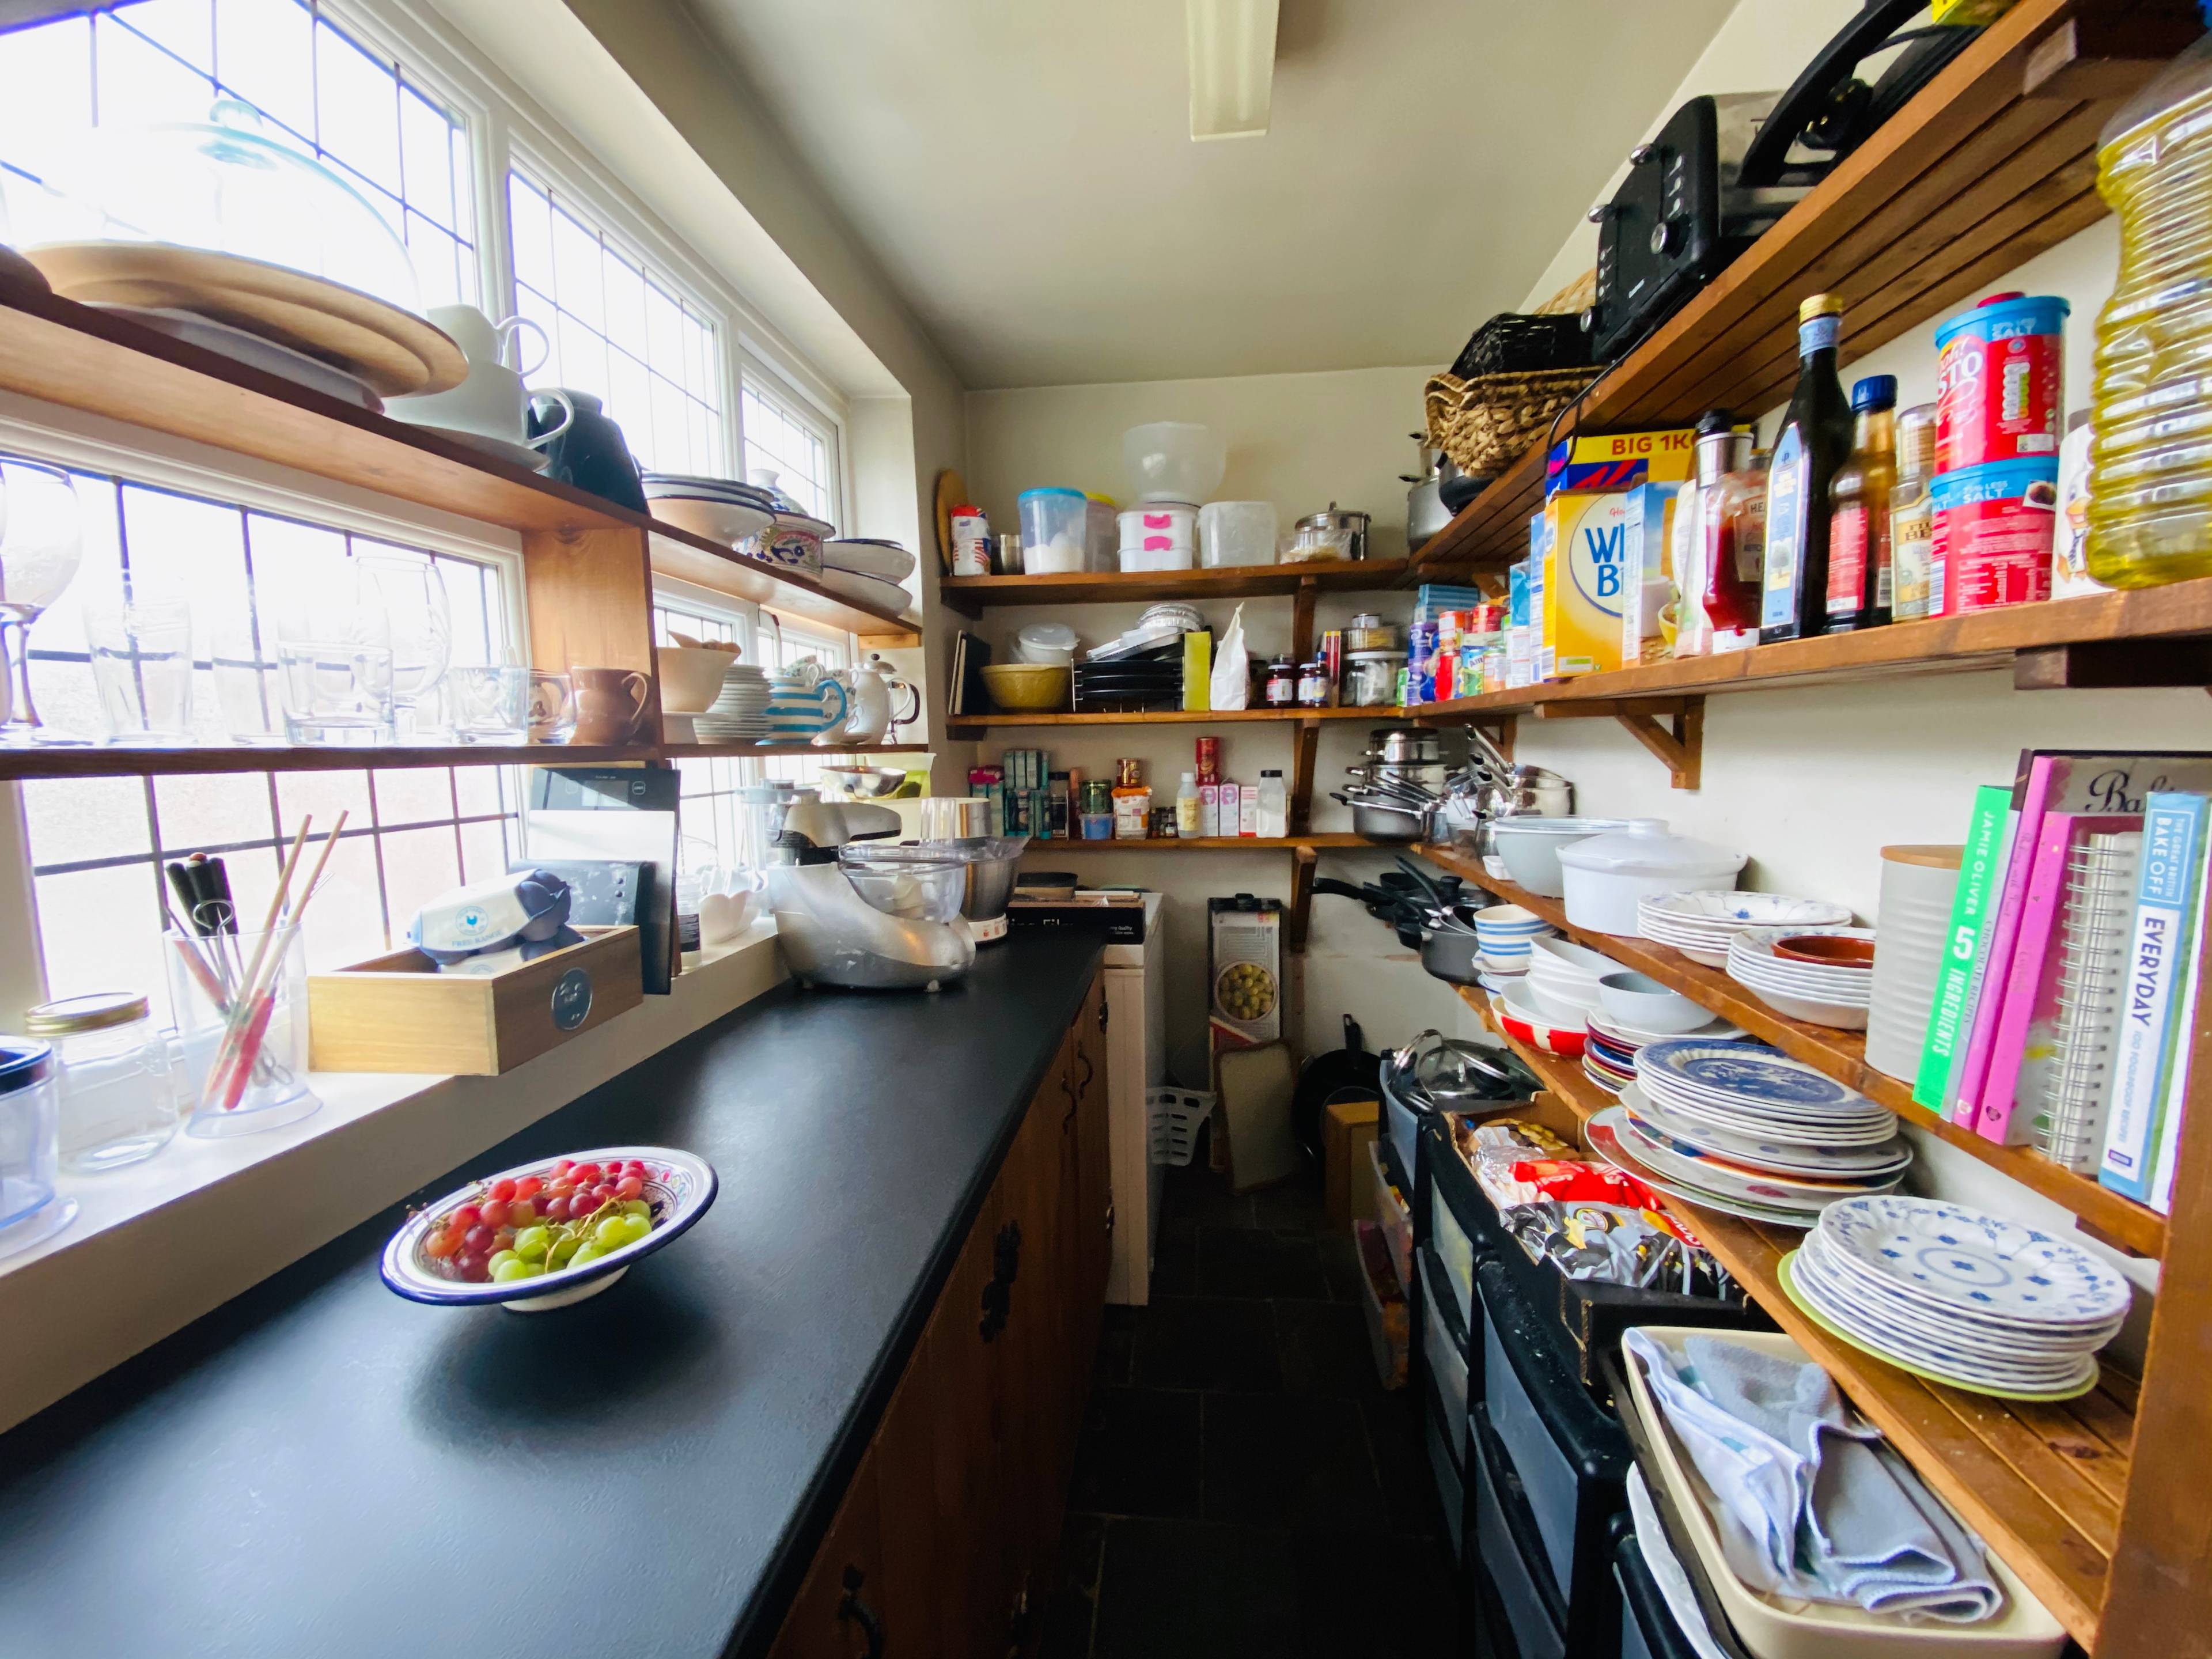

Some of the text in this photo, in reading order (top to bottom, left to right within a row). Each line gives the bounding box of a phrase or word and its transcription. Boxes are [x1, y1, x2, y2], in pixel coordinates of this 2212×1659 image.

[1938, 351, 1983, 400] STO
[1612, 437, 1652, 455] BIG
[1750, 502, 1766, 514] HE
[1963, 488, 2003, 504] SALT
[2170, 836, 2182, 864] GREAT
[2173, 818, 2186, 834] THE
[1964, 811, 1995, 915] JAMIE OLIVER
[2147, 817, 2173, 895] BAKE OFF
[1931, 925, 1976, 1057] 5 INGREDIENTS
[1963, 921, 1993, 1024] CHOCOLATE RECIPES
[2131, 917, 2166, 1027] EVERYDAY
